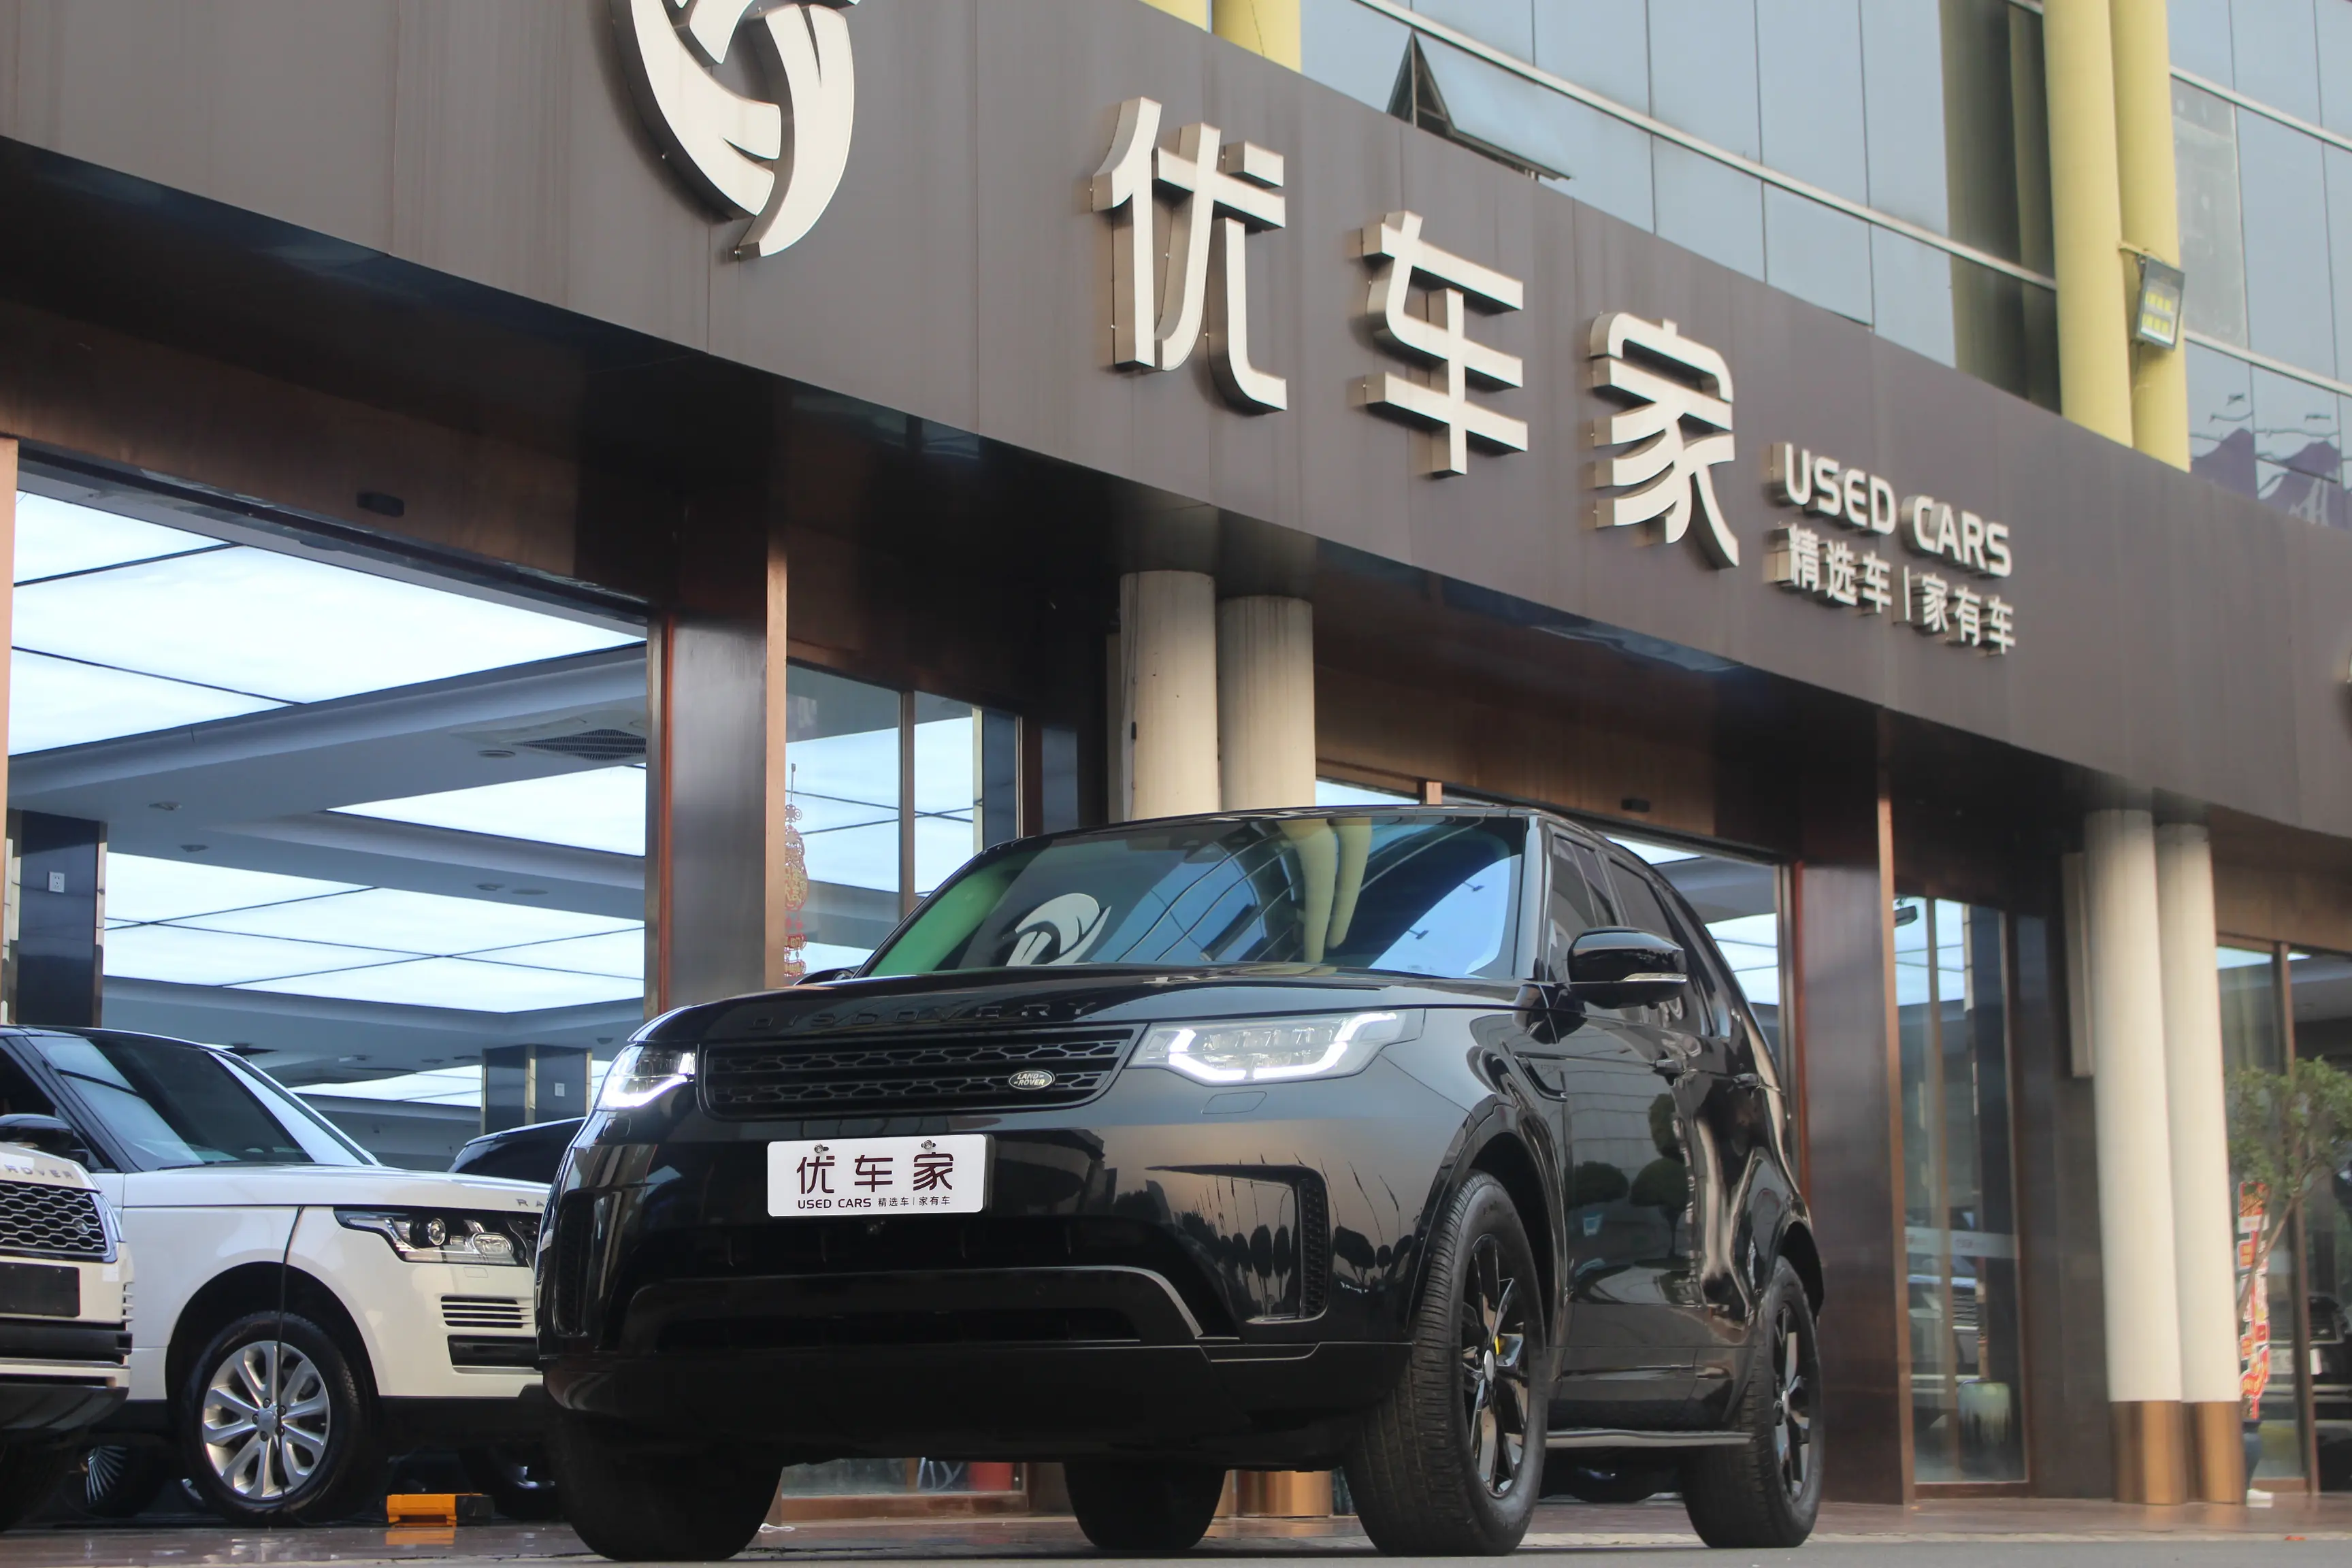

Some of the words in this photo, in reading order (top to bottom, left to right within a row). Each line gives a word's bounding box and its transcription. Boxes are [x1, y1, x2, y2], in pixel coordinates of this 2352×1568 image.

[1093, 97, 1739, 568] 优车家
[1782, 442, 1897, 536] USED
[1911, 495, 2012, 578] CARS
[1788, 523, 1893, 614] 精选车
[1921, 573, 2016, 655] 家有车
[749, 1001, 1096, 1030] DISCOVERY
[5, 1164, 74, 1179] ROVER
[796, 1152, 954, 1194] 优车家
[798, 1199, 832, 1209] USED
[838, 1198, 872, 1208] CARS
[878, 1196, 909, 1207] 精选车
[918, 1196, 951, 1206] 家有车
